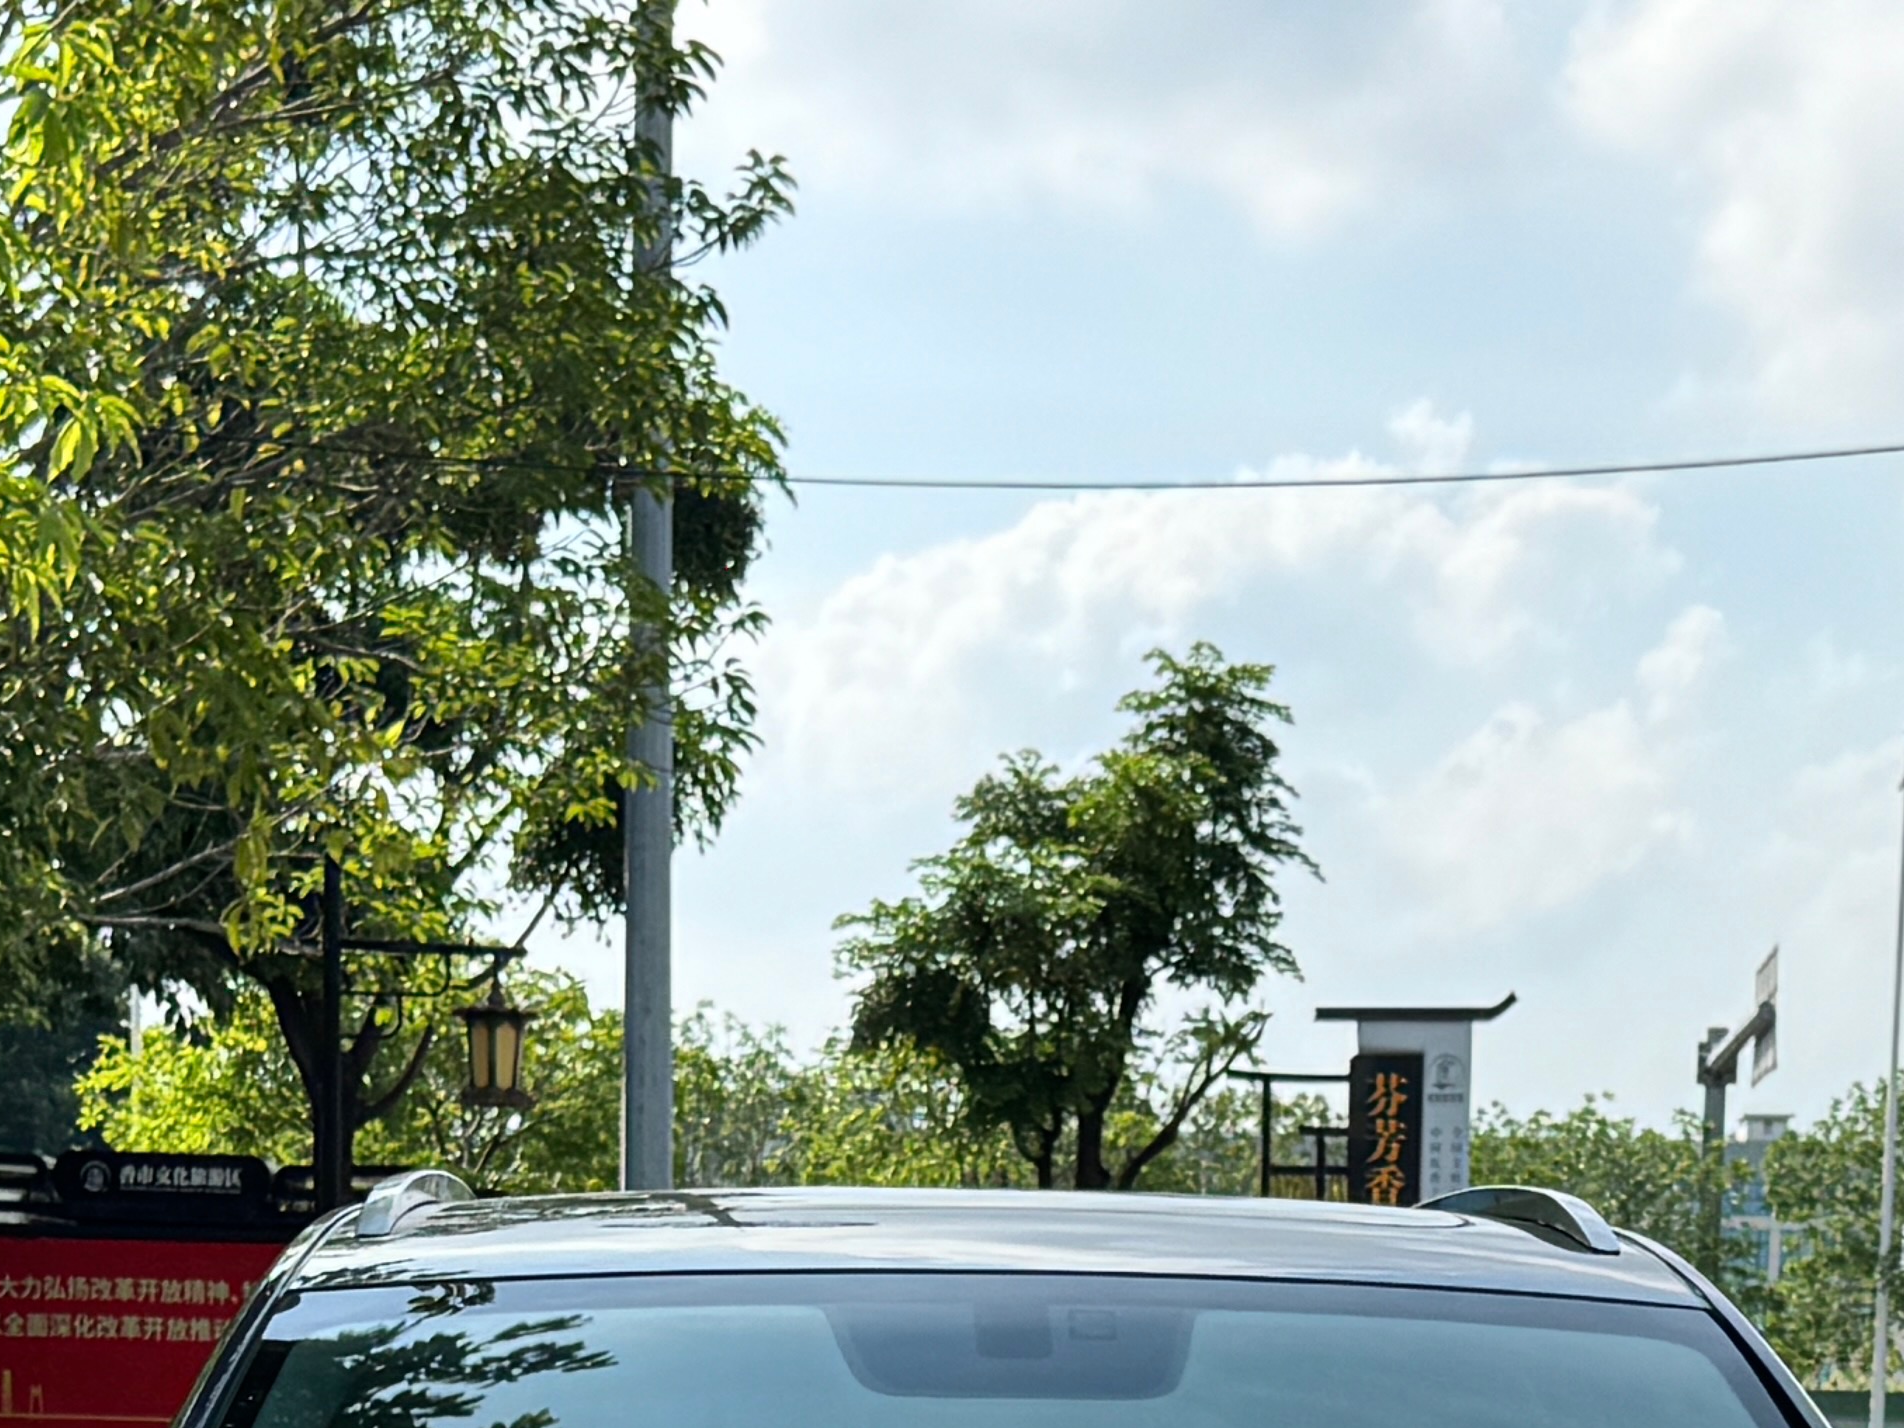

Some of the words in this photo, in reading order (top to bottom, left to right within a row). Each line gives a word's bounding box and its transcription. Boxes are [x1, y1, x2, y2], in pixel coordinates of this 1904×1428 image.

[119, 1164, 242, 1187] 香市文化旅游区
[1366, 1073, 1408, 1205] 芬芳香
